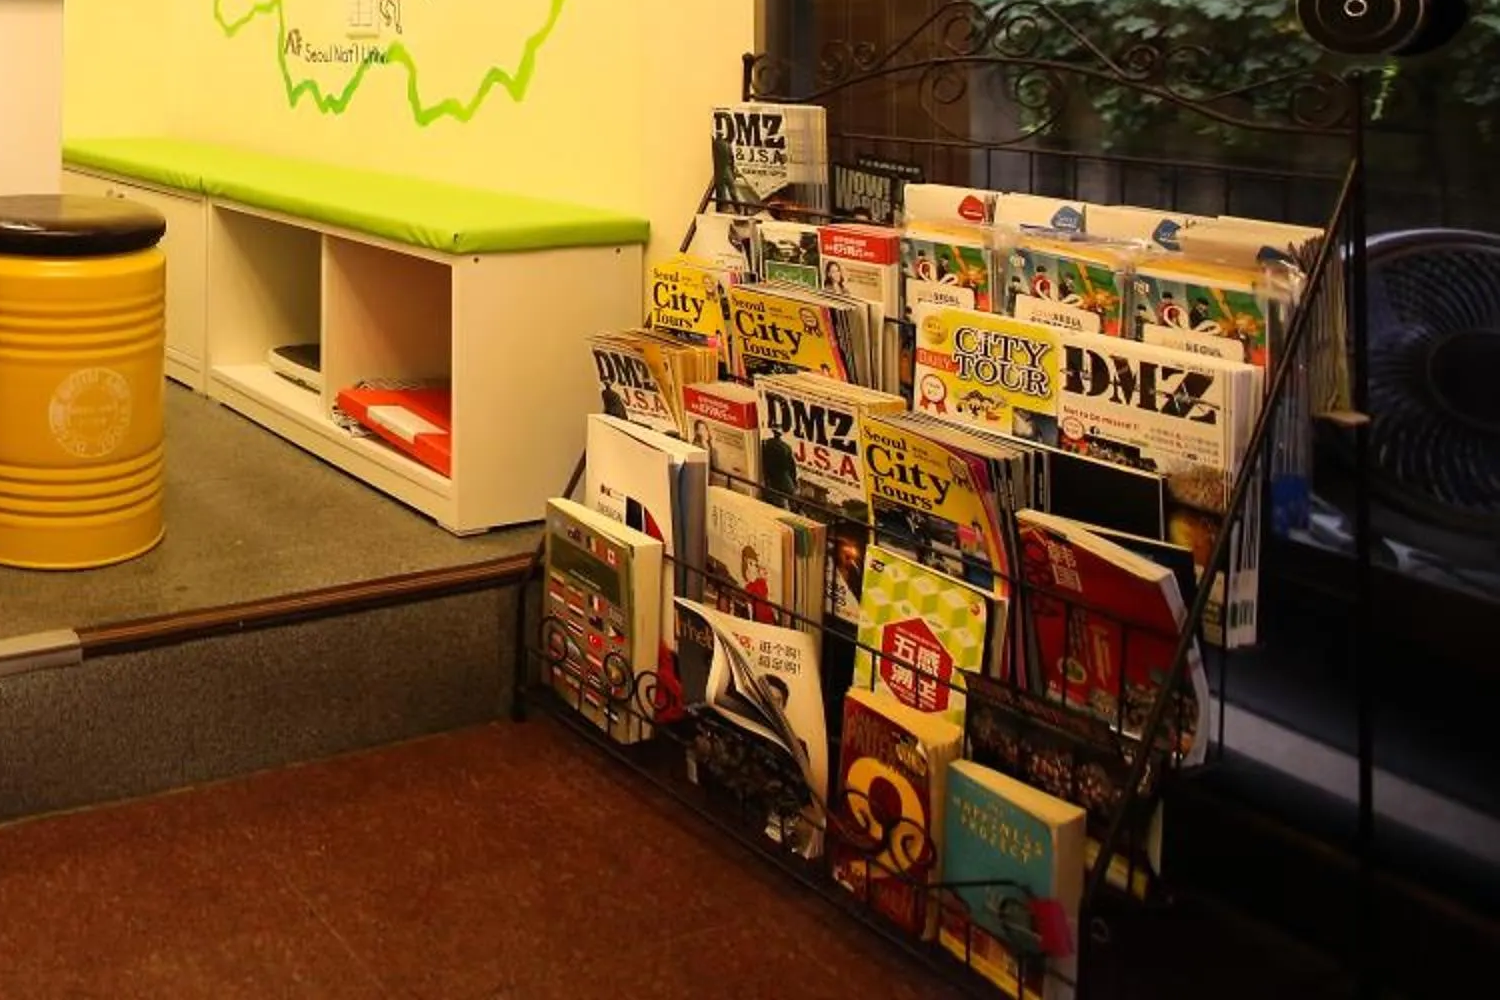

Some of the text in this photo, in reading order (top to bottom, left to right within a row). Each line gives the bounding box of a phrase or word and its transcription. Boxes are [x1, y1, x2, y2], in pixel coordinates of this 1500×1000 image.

[712, 111, 787, 150] DMZ
[653, 281, 705, 323] City
[734, 309, 802, 355] City
[954, 326, 1051, 369] CITY
[955, 352, 1051, 398] TOUR
[1061, 343, 1219, 425] DMZ
[764, 389, 859, 457] DMZ
[865, 443, 951, 506] City
[869, 473, 933, 511] Tours
